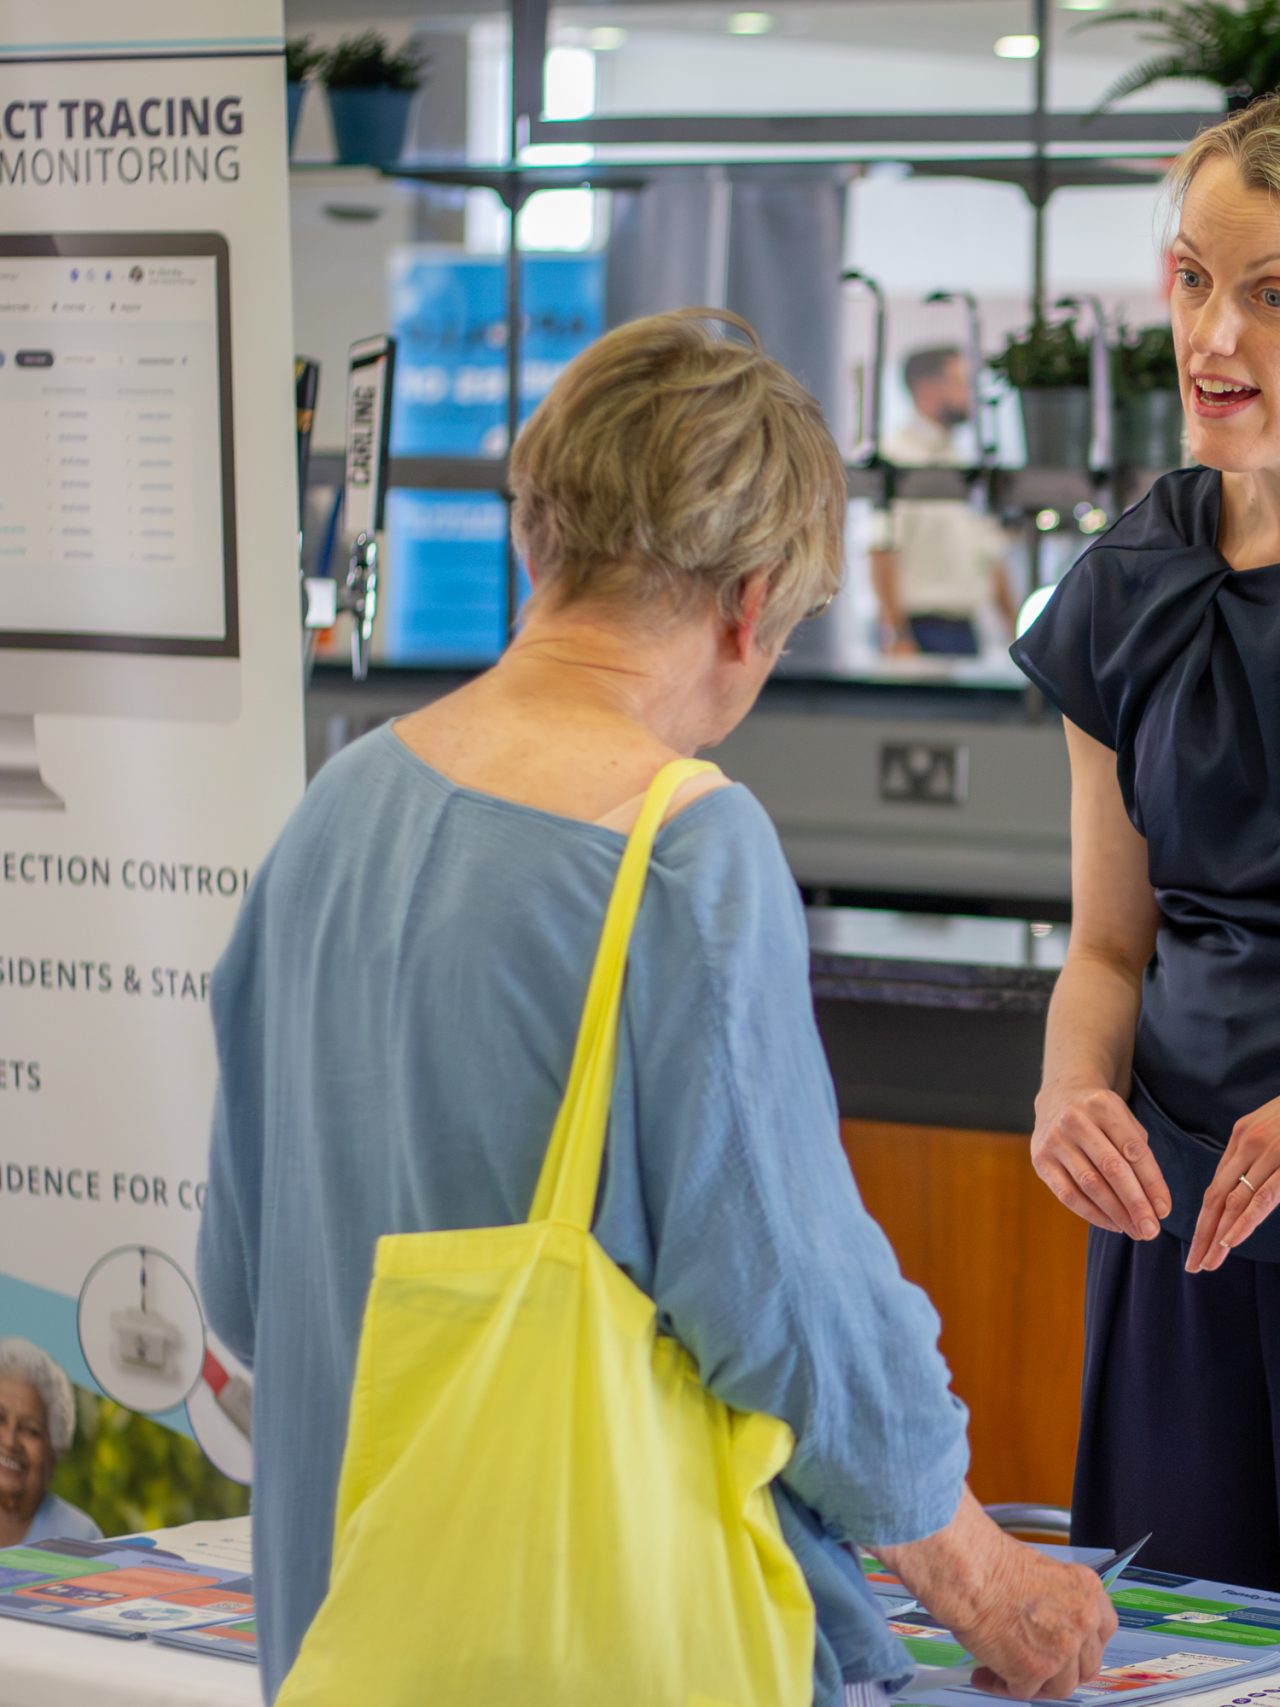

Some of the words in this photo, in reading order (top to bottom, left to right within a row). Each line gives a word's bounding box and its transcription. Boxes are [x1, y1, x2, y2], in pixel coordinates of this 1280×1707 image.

[0, 101, 48, 140] CT
[59, 96, 243, 139] TRACING
[0, 145, 240, 185] MONITORING
[352, 385, 375, 487] CARLING
[3, 852, 110, 887] ECTION
[124, 964, 141, 995] &
[113, 1172, 169, 1207] FOR
